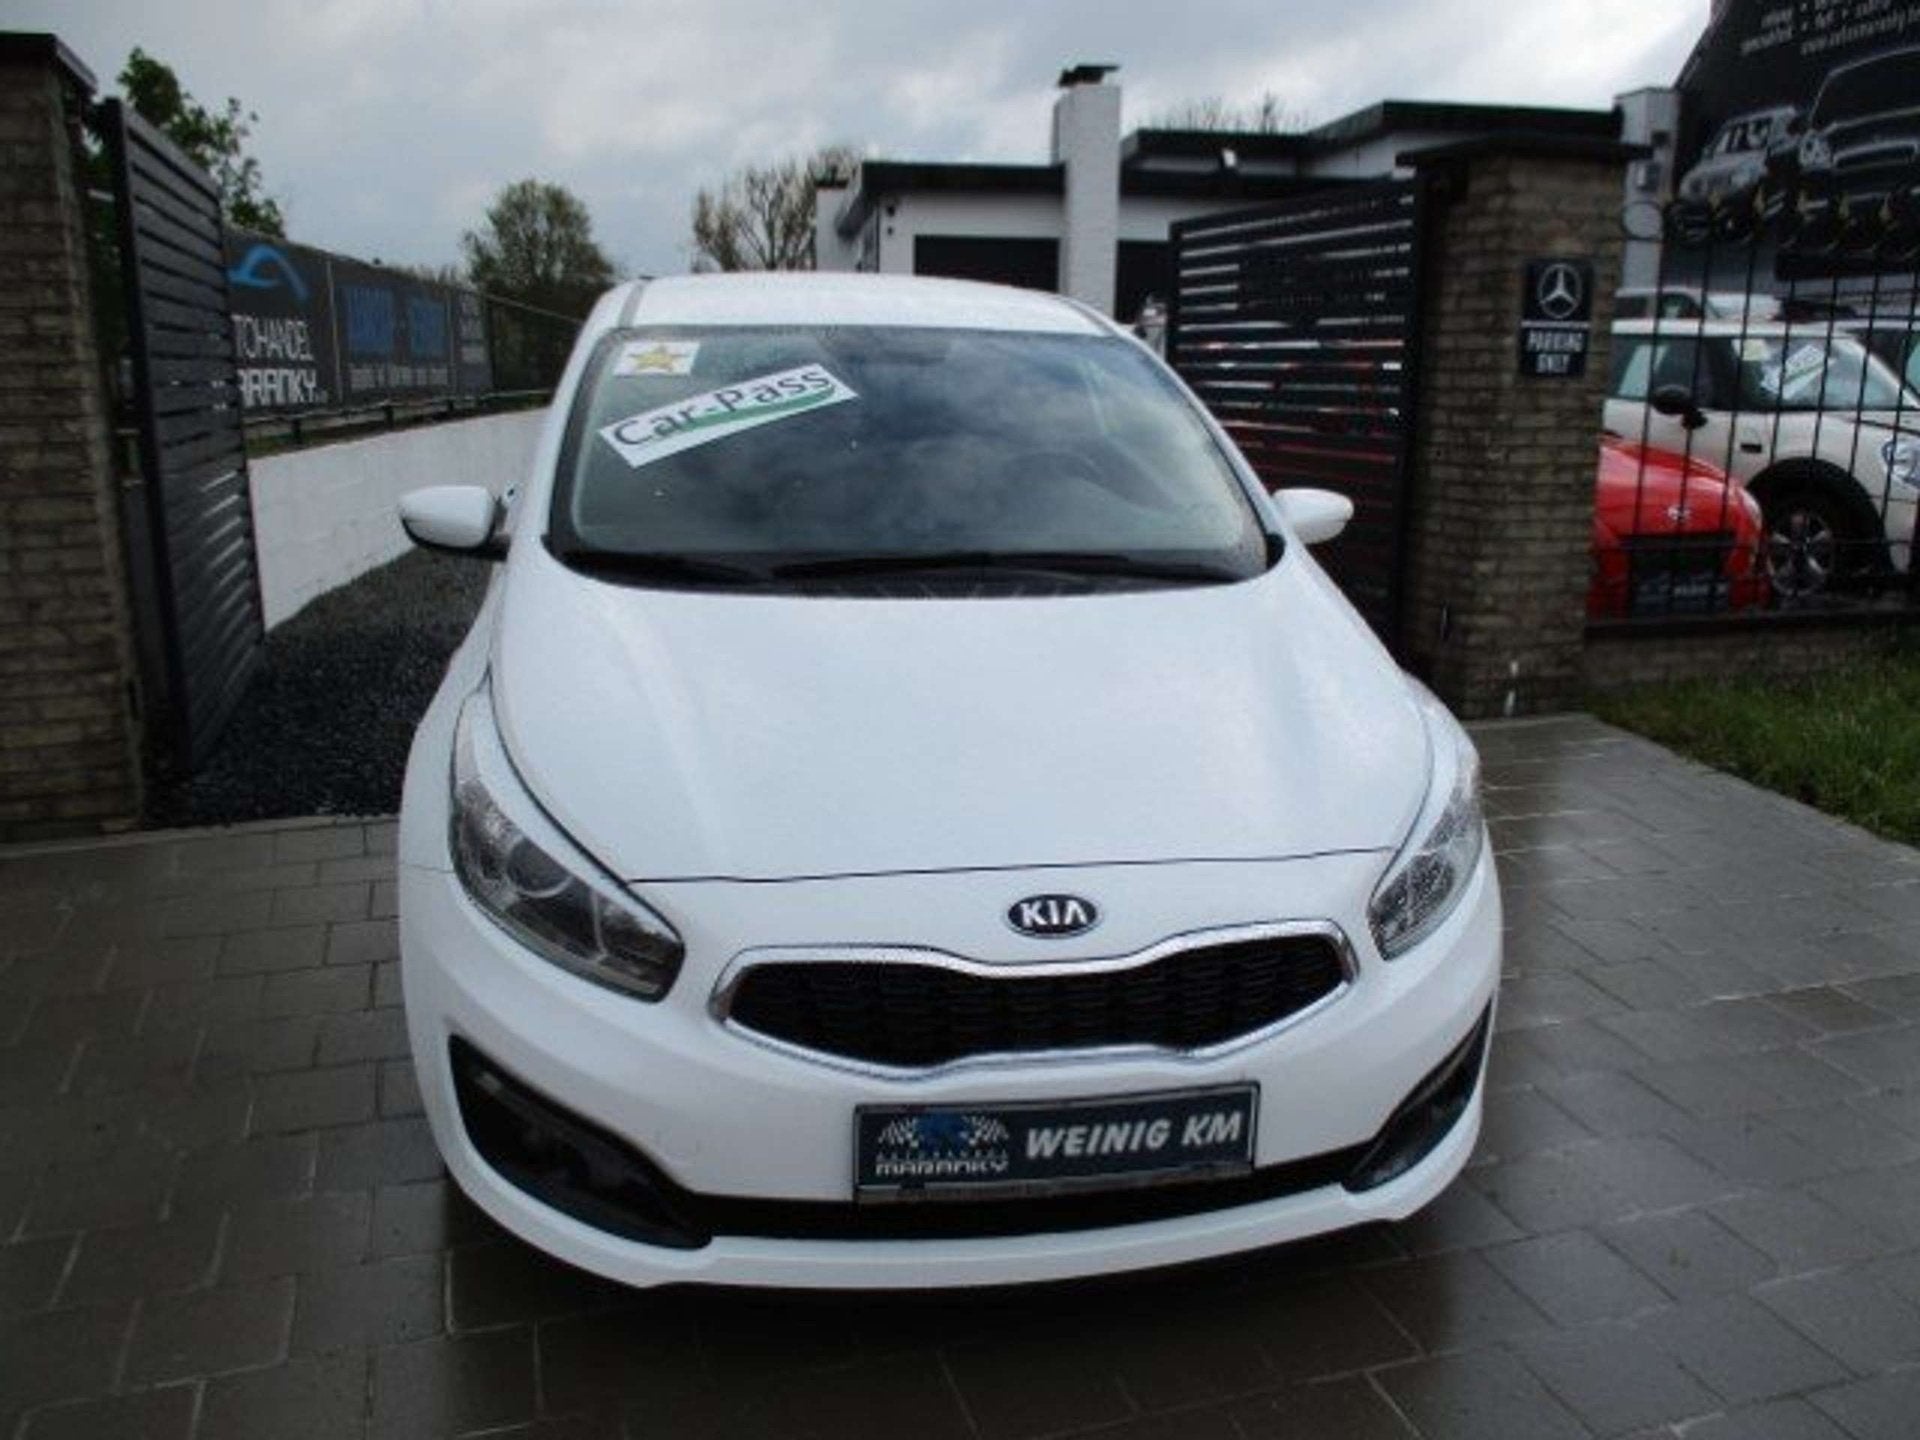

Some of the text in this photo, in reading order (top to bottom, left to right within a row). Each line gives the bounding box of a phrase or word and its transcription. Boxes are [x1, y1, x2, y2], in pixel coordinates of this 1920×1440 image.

[613, 370, 831, 446] Car-Pass
[1020, 899, 1088, 928] KIA
[1025, 1111, 1243, 1159] WEINIG KM
